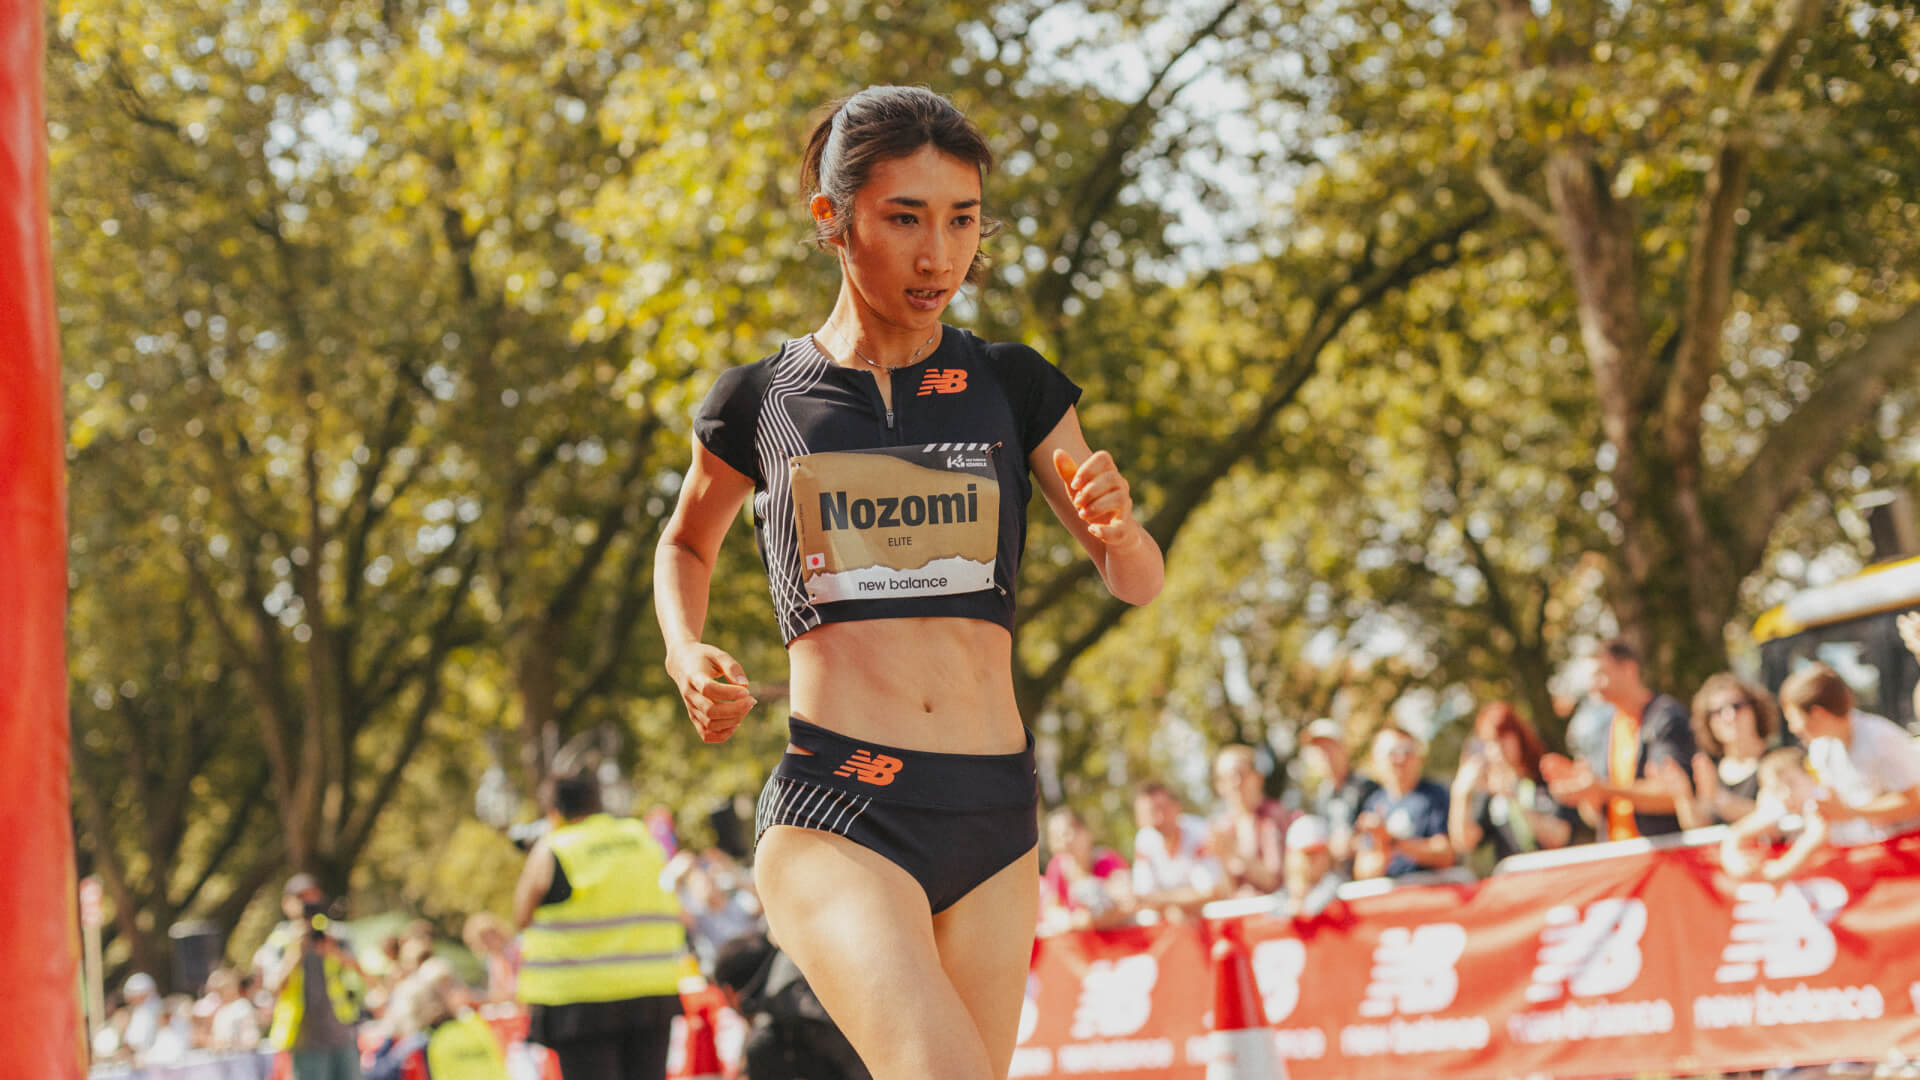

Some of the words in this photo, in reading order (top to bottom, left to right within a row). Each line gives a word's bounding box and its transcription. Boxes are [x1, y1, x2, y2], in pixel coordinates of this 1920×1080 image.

[916, 368, 968, 396] NB
[819, 483, 978, 532] Nozomi
[888, 536, 913, 547] ELITE
[858, 580, 886, 591] new
[889, 576, 948, 590] balance
[833, 749, 904, 786] NB
